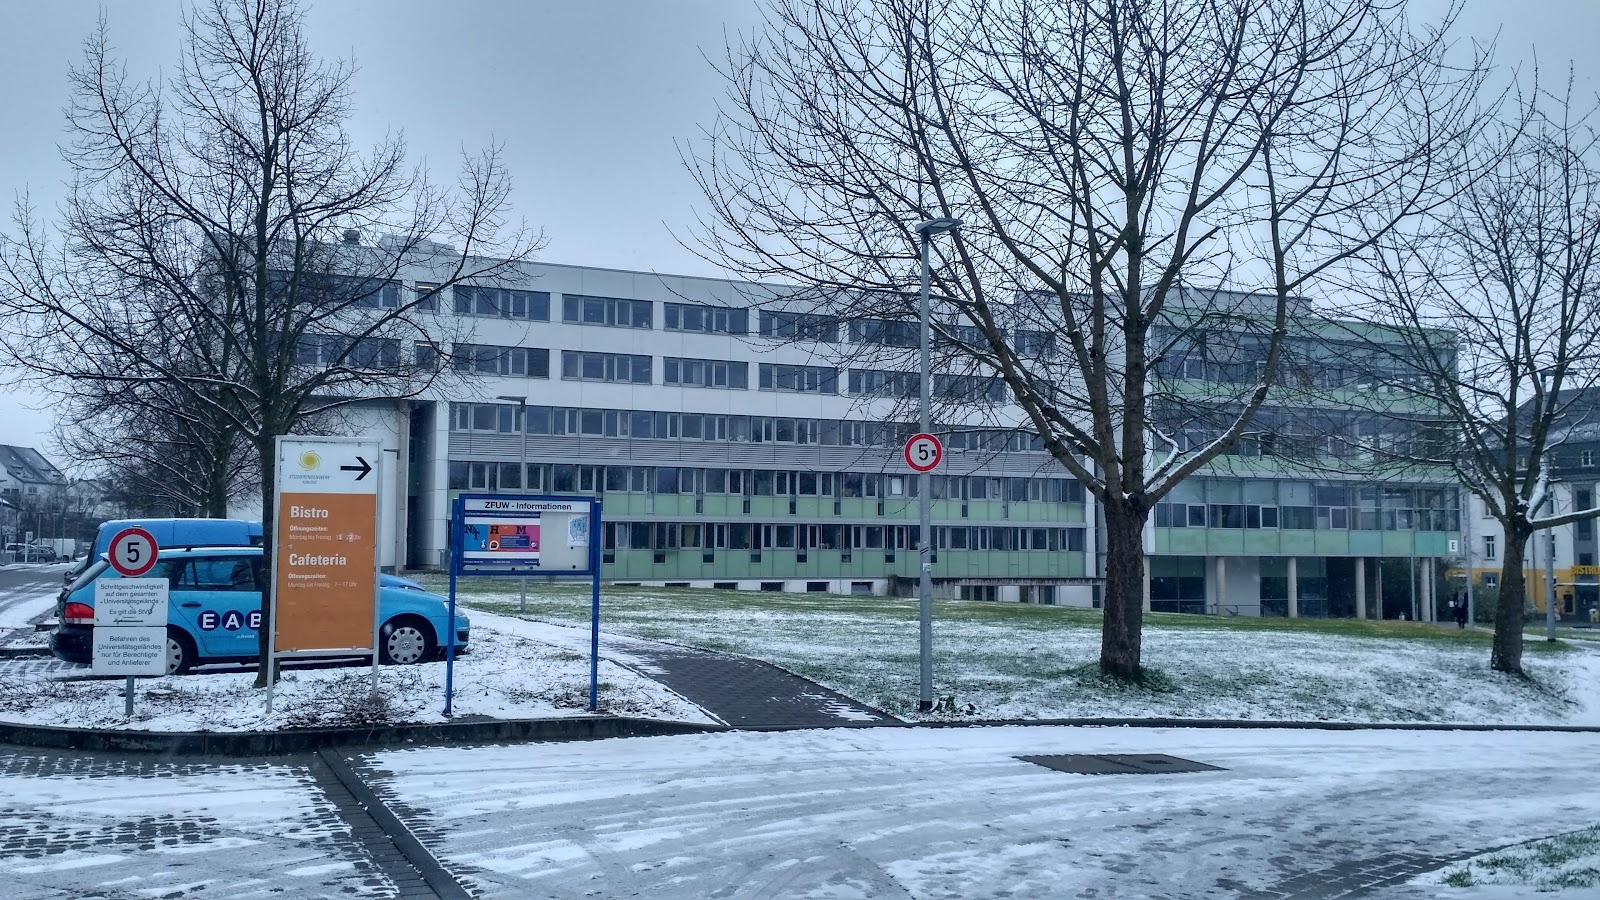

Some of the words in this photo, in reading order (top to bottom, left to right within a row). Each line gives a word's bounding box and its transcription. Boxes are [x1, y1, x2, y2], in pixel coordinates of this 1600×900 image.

[919, 444, 929, 461] 5
[485, 501, 510, 509] ZFUW
[516, 502, 572, 511] Informationen
[290, 505, 329, 519] Bistro
[490, 525, 500, 535] H
[516, 525, 527, 535] M
[1451, 541, 1456, 550] E
[127, 542, 140, 563] 5
[289, 553, 347, 566] Cafeteria
[129, 591, 158, 599] gesamten
[103, 598, 159, 606] Universitätsgelände
[117, 608, 127, 616] gilt
[122, 651, 158, 659] Berechtigte
